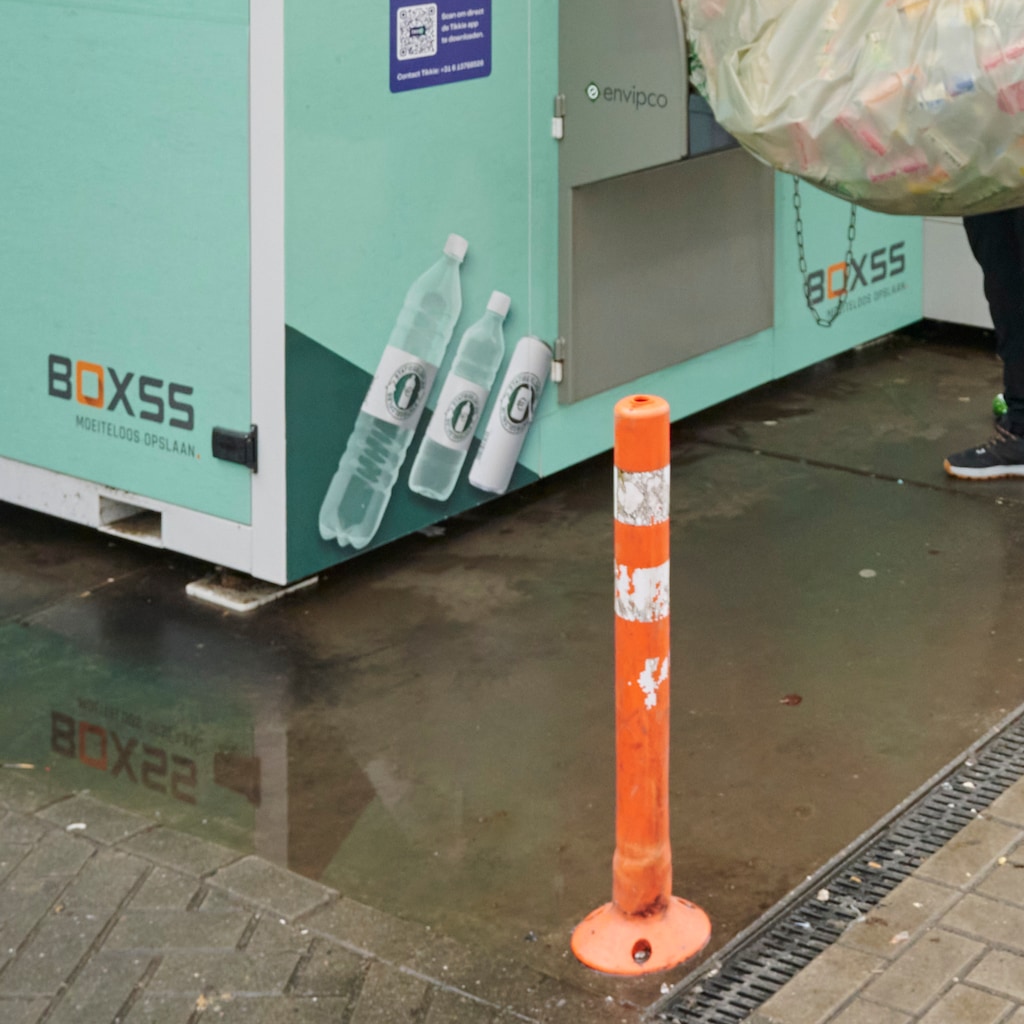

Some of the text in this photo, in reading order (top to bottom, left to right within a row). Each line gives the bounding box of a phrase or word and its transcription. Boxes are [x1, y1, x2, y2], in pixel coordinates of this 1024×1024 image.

[602, 84, 669, 110] envipco
[807, 240, 906, 306] BOXSS
[48, 353, 195, 431] BOXSS
[75, 414, 201, 459] MOEITELOOS OPSLAAN.
